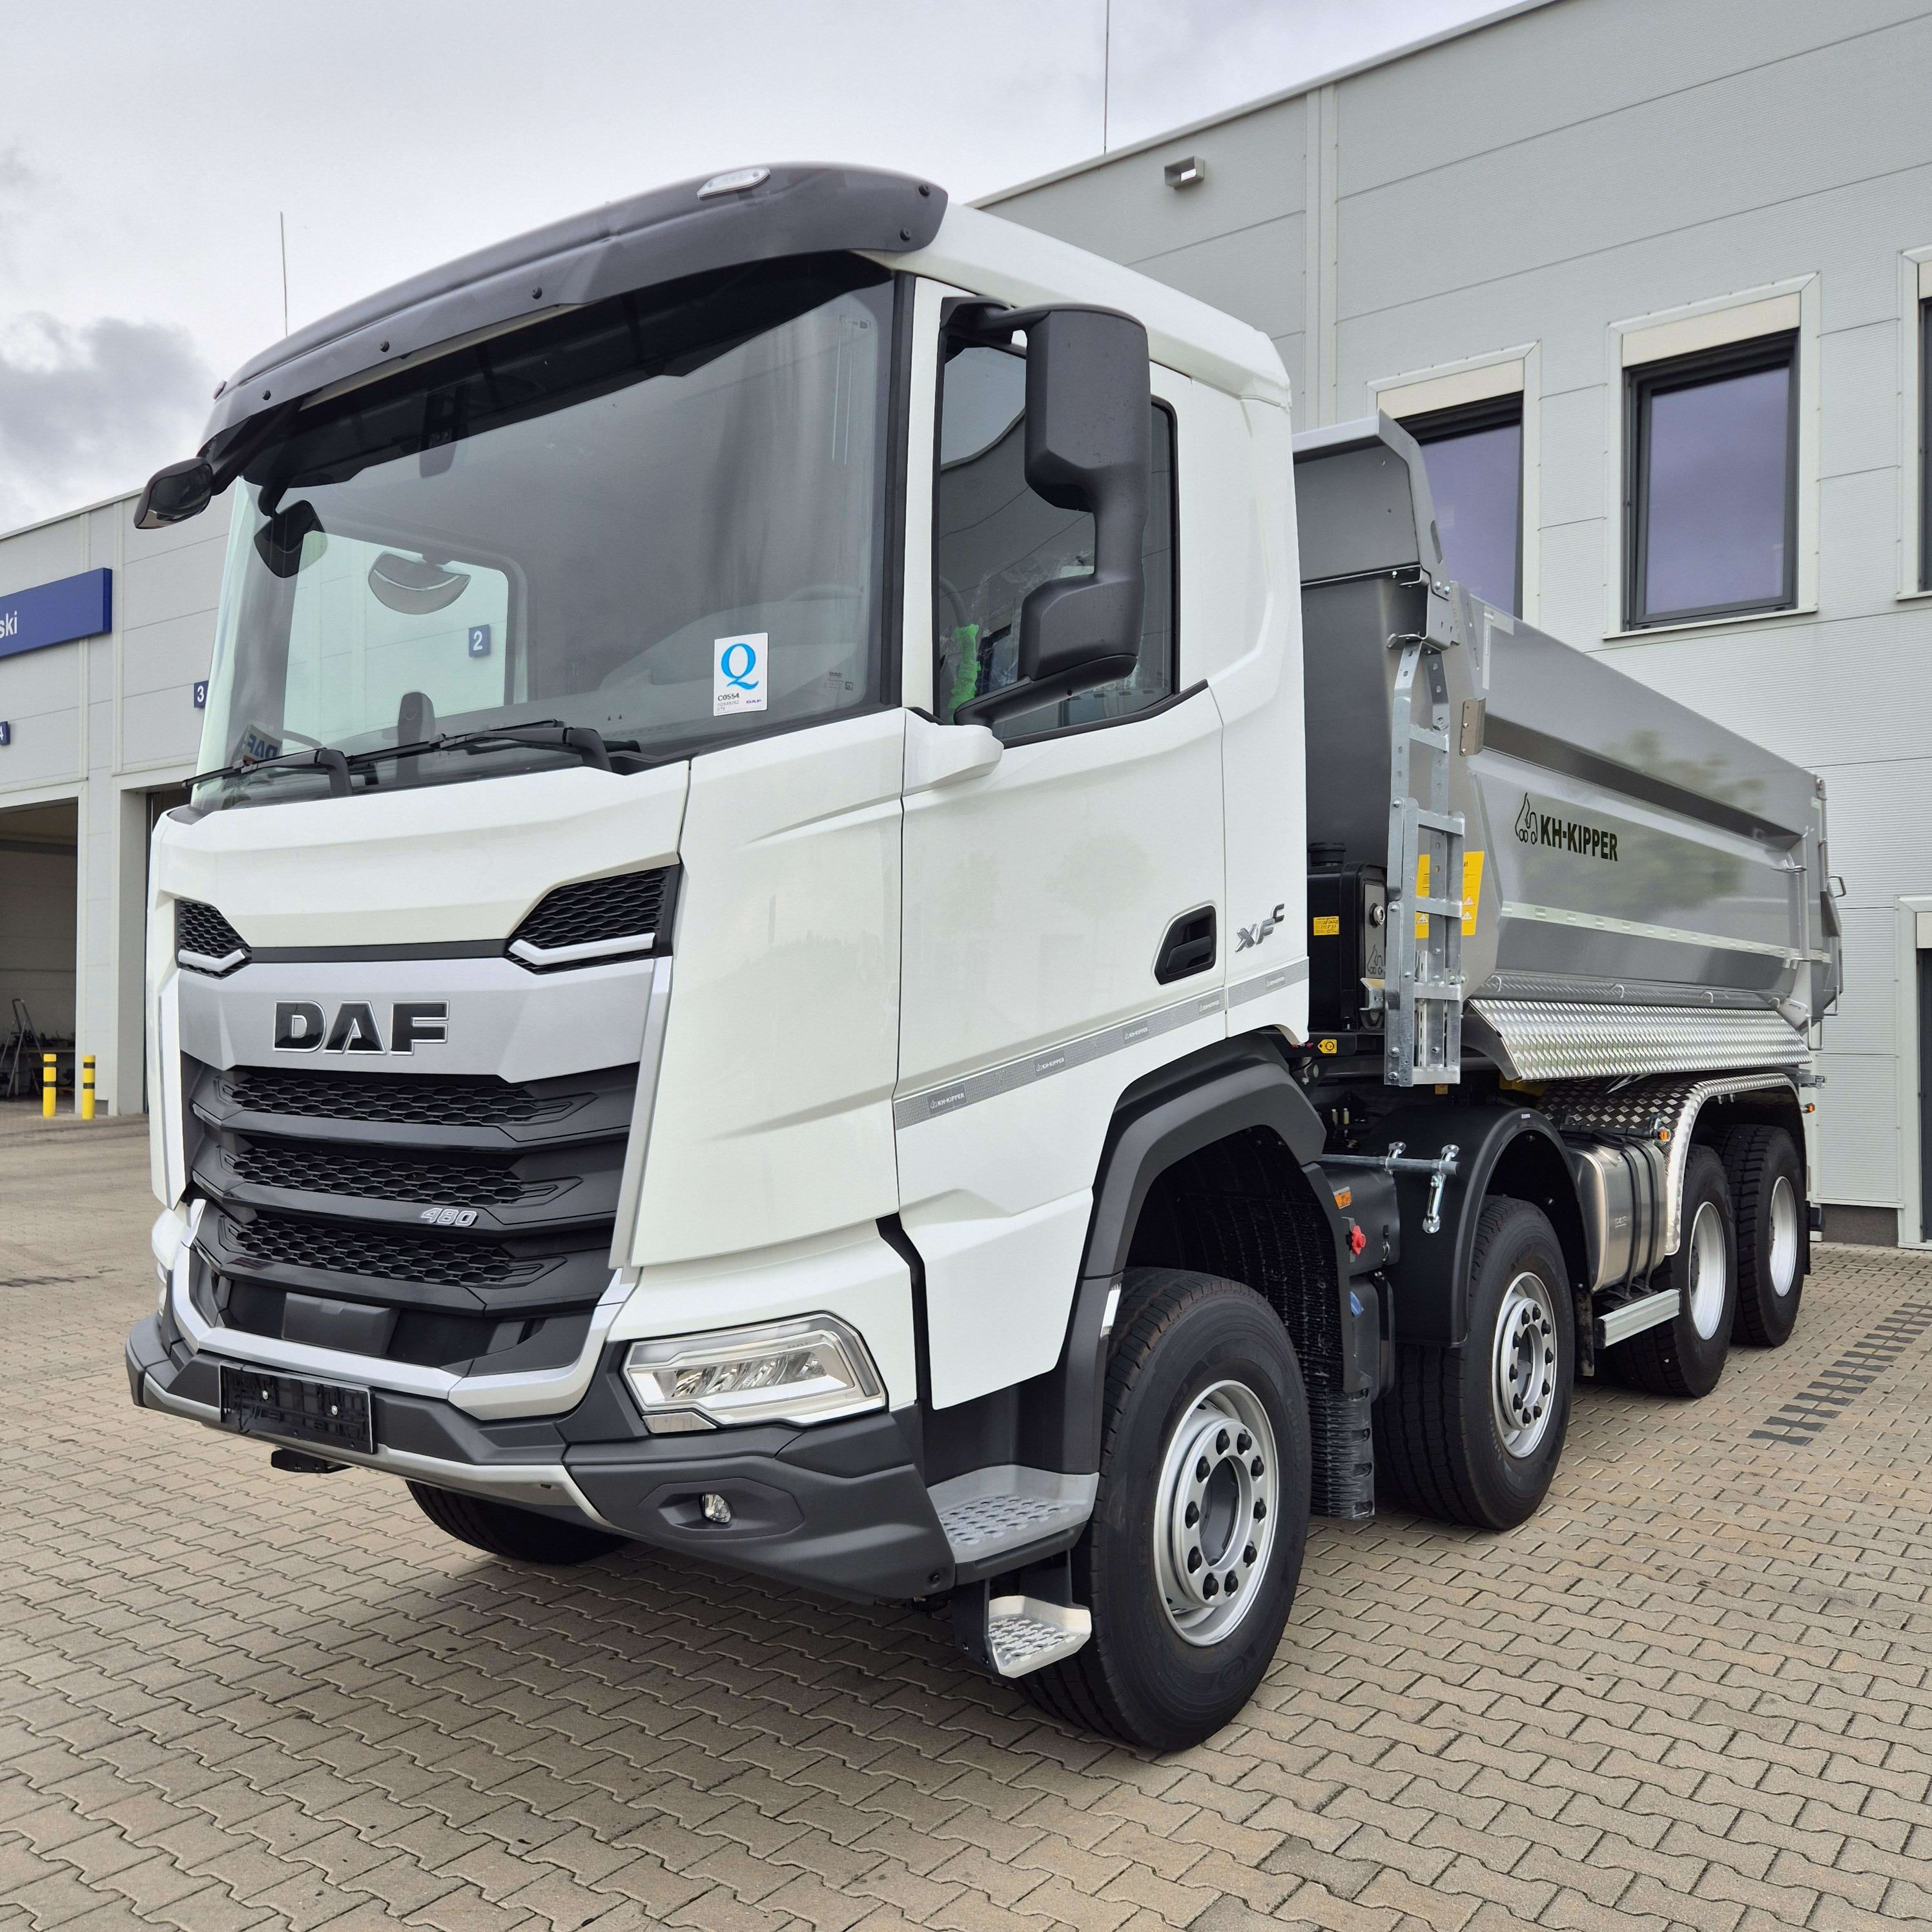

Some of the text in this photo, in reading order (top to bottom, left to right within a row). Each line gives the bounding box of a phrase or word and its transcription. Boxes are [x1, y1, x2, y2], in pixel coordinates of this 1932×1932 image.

[473, 630, 483, 651] 2
[721, 643, 759, 690] Q
[197, 685, 205, 703] 3
[717, 692, 740, 701] C0554
[1541, 814, 1618, 862] KH-KIPPER
[273, 1000, 450, 1056] DAF
[1042, 1056, 1065, 1069] KH-KIPPER
[937, 1092, 965, 1106] KH-KIPPER
[420, 1207, 478, 1227] 480
